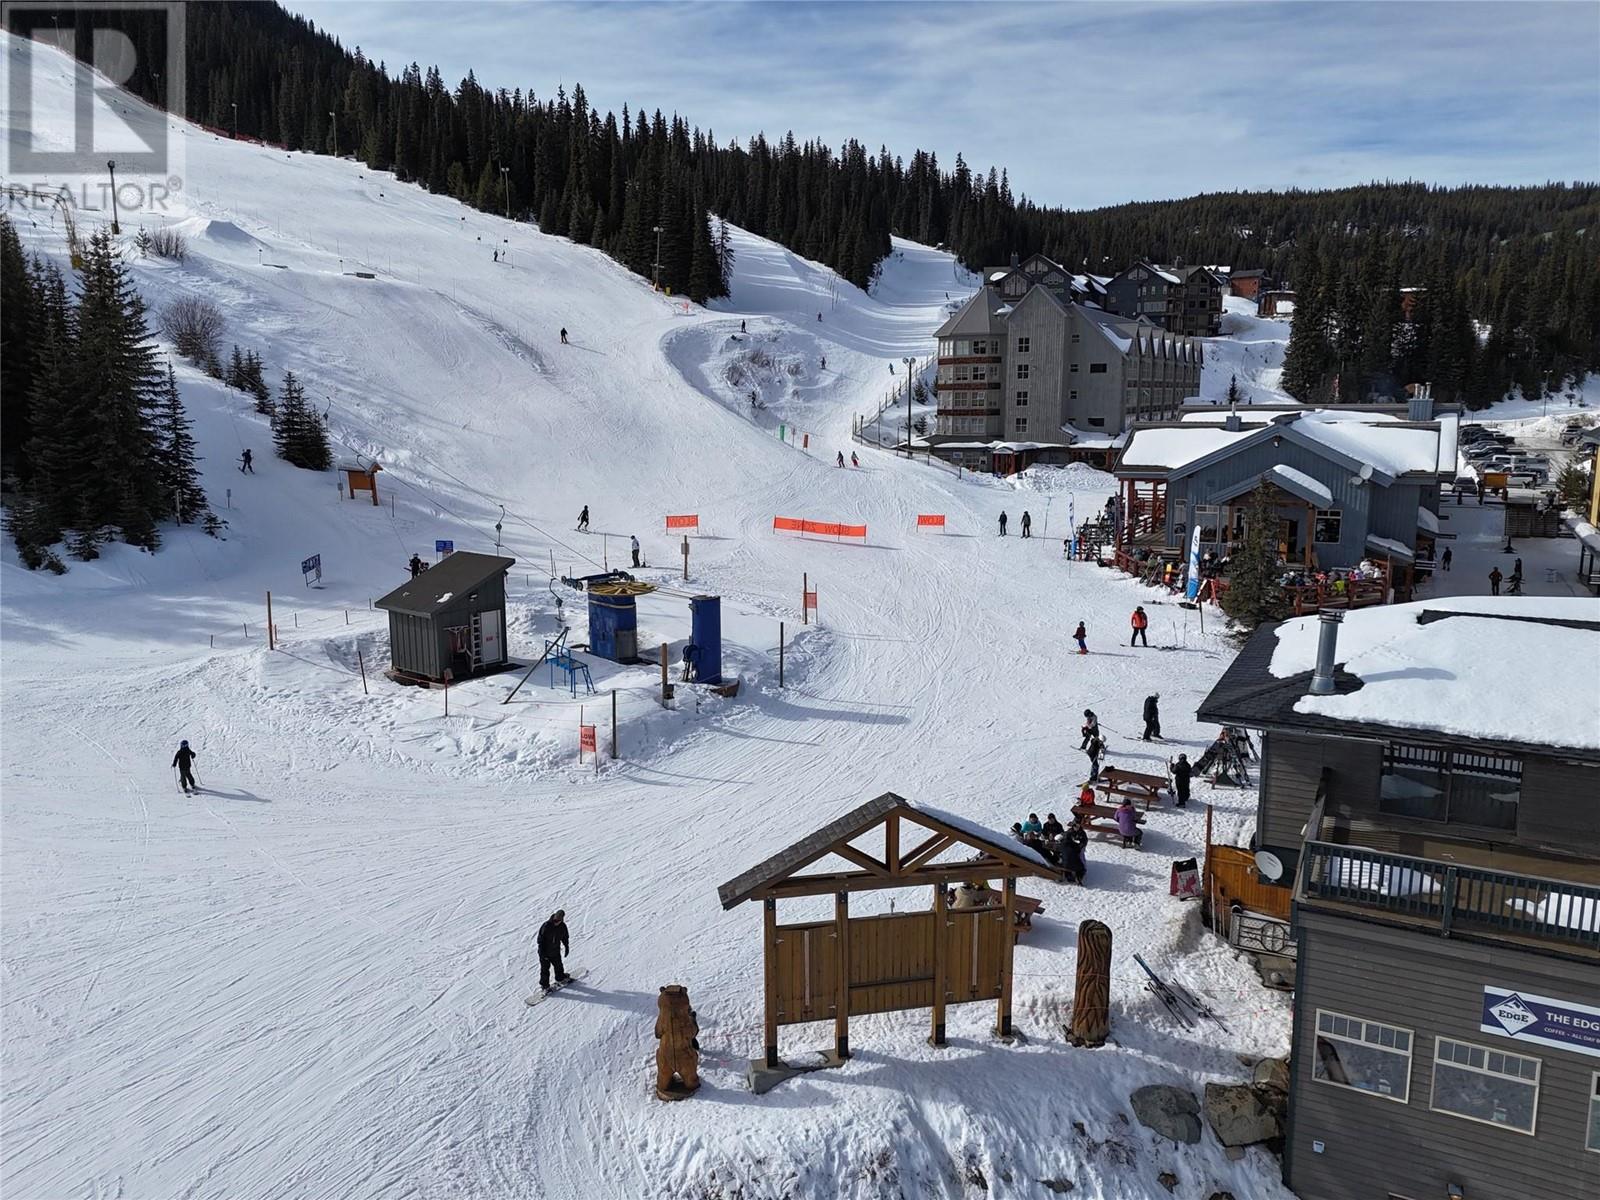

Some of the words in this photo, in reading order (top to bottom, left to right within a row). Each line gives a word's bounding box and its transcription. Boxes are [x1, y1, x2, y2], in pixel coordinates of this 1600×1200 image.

[1498, 1010, 1529, 1023] EDGE
[1545, 1011, 1570, 1025] THE
[1544, 1027, 1565, 1036] COFFEE
